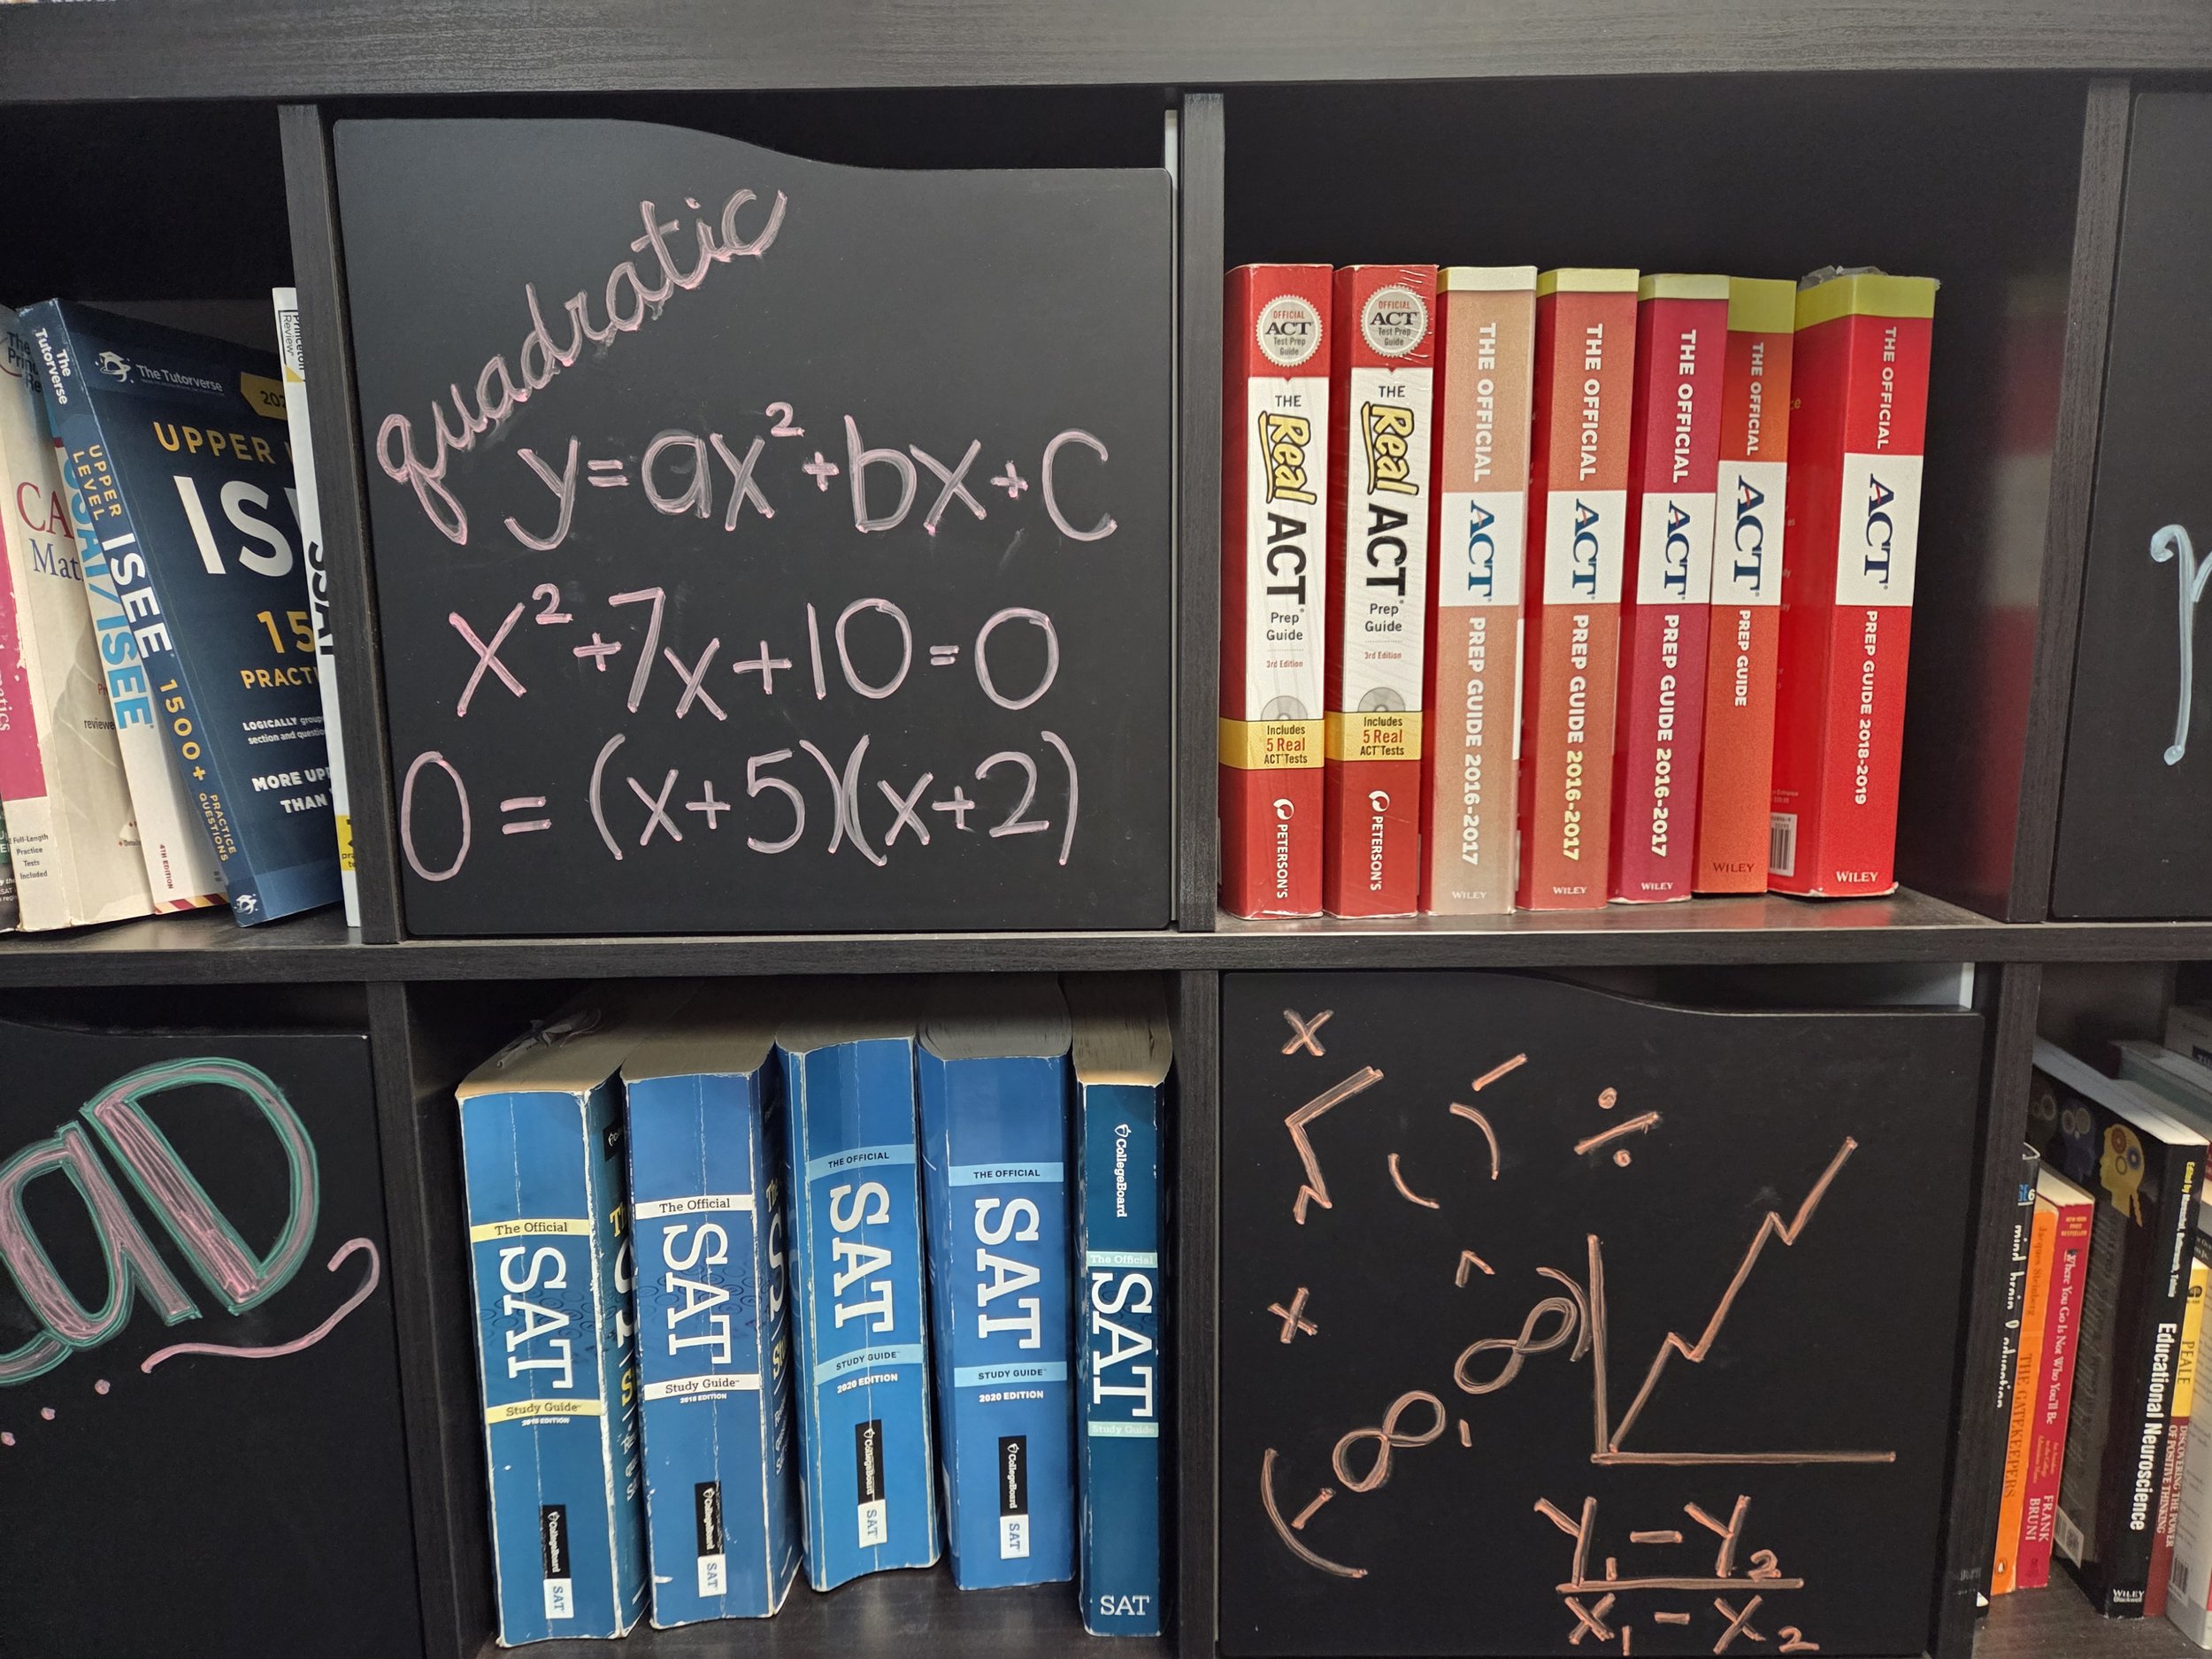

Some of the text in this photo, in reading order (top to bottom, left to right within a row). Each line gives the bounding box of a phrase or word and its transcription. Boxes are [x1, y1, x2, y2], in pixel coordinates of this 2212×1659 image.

[1272, 311, 1305, 319] OFFICIAL
[1379, 301, 1411, 310] OFFICIAL
[1265, 321, 1312, 335] ACT
[1370, 311, 1419, 326] ACT
[7, 332, 30, 354] The
[283, 314, 295, 356] Review
[1274, 336, 1306, 346] Test Prep
[1379, 327, 1411, 337] Test Prep
[1385, 337, 1404, 346] Guide
[57, 349, 72, 377] The
[1279, 347, 1300, 356] Guide
[35, 327, 68, 405] Tutorverse
[377, 189, 787, 545] quadratic
[136, 364, 160, 380] The
[160, 369, 223, 393] Tutorverse
[1877, 326, 1896, 449] THE OFFICIAL
[1275, 396, 1302, 407] THE
[1379, 386, 1406, 397] THE
[1474, 322, 1496, 483] THE OFFICIAL
[1579, 323, 1603, 481] THE OFFICIAL
[1747, 342, 1763, 456] THE OFFICIAL
[1672, 329, 1696, 483] THE OFFICIAL
[153, 421, 275, 465] UPPER
[1371, 403, 1419, 495] Real
[1267, 413, 1317, 505] Real
[73, 451, 104, 521] LEVEL
[89, 444, 122, 518] UPPER
[1733, 474, 1765, 591] ACT
[1864, 473, 1894, 585] ACT
[1266, 511, 1307, 605] ACT
[1366, 503, 1409, 596] ACT
[1468, 499, 1495, 598] ACT
[1572, 498, 1600, 596] ACT
[1663, 500, 1691, 596] ACT
[102, 533, 173, 659] ISEE
[1271, 611, 1300, 626] Prep
[1370, 603, 1399, 616] Prep
[1266, 629, 1303, 641] Guide
[1364, 620, 1402, 633] Guide
[1734, 610, 1752, 707] PREP GUIDE
[1855, 611, 1878, 805] PREP GUIDE 2018-2019
[159, 679, 206, 781] 1500+
[242, 717, 297, 731] LOGICALLY
[1267, 726, 1306, 736] Includes
[1363, 716, 1402, 726] Includes
[248, 731, 296, 745] section and
[1266, 737, 1305, 752] 5 Real
[1363, 729, 1402, 743] 5 Real
[1462, 617, 1486, 865] PREP GUIDE 2016-2017
[1563, 615, 1589, 861] PREP GUIDE 2016-2017
[1651, 615, 1679, 857] PREP GUIDE 2016-2017
[1285, 754, 1308, 764] Tests
[1381, 745, 1404, 756] Tests
[251, 771, 303, 792] MORE
[280, 794, 327, 813] THAN
[199, 792, 228, 862] QUESTIONS
[210, 795, 237, 854] PRACTICE
[13, 833, 49, 844] Full-Length
[17, 847, 42, 856] Practice
[1277, 824, 1288, 899] PETERSON'S
[1371, 816, 1384, 891] PETERSON'S
[20, 871, 48, 879] Included
[162, 860, 174, 889] EDITION
[1713, 863, 1754, 873] WILEY
[1836, 871, 1878, 883] WILEY
[1452, 890, 1487, 900] WILEY
[1553, 886, 1586, 895] WILEY
[1640, 881, 1673, 891] WILEY
[828, 1151, 889, 1168] THE OFFICIAL
[995, 1168, 1041, 1178] OFFICIAL
[1114, 1138, 1127, 1217] CollegeBoard
[659, 1197, 731, 1213] The Official
[495, 1221, 568, 1235] The Official
[829, 1181, 894, 1333] SAT
[1090, 1254, 1154, 1264] The Official
[974, 1197, 1041, 1349] SAT
[2062, 1254, 2077, 1285] Where
[664, 1223, 731, 1364] SAT
[2060, 1286, 2073, 1305] You
[499, 1246, 573, 1389] SAT
[2059, 1307, 2070, 1323] Go
[2057, 1325, 2068, 1333] Is
[1091, 1272, 1153, 1417] SAT
[2055, 1335, 2067, 1355] Not
[836, 1351, 897, 1371] STUDY GUIDE
[2016, 1353, 2032, 1386] THE
[2052, 1356, 2063, 1381] Who
[2177, 1340, 2195, 1385] PEALE
[837, 1373, 898, 1394] 2020 EDITION
[979, 1368, 1043, 1379] STUDY GUIDE
[665, 1378, 735, 1394] Study Guide
[698, 1393, 727, 1402] EDITION
[979, 1390, 1044, 1402] 2020 EDITION
[2047, 1382, 2061, 1409] You'll
[506, 1402, 579, 1417] Study Guide
[540, 1417, 570, 1425] EDITION
[2047, 1411, 2057, 1425] Be
[1092, 1425, 1155, 1435] Study Guide
[2130, 1323, 2177, 1532] Educational Neuroscience
[2003, 1390, 2028, 1499] GATEKEEPERS
[1007, 1454, 1018, 1509] CollegeBoard
[866, 1509, 878, 1537] SAT
[2025, 1497, 2041, 1540] BRUNI
[2039, 1495, 2054, 1541] FRANK
[1009, 1523, 1020, 1551] SAT
[708, 1563, 718, 1587] SAT
[553, 1586, 564, 1611] SAT
[1099, 1594, 1149, 1617] SAT
